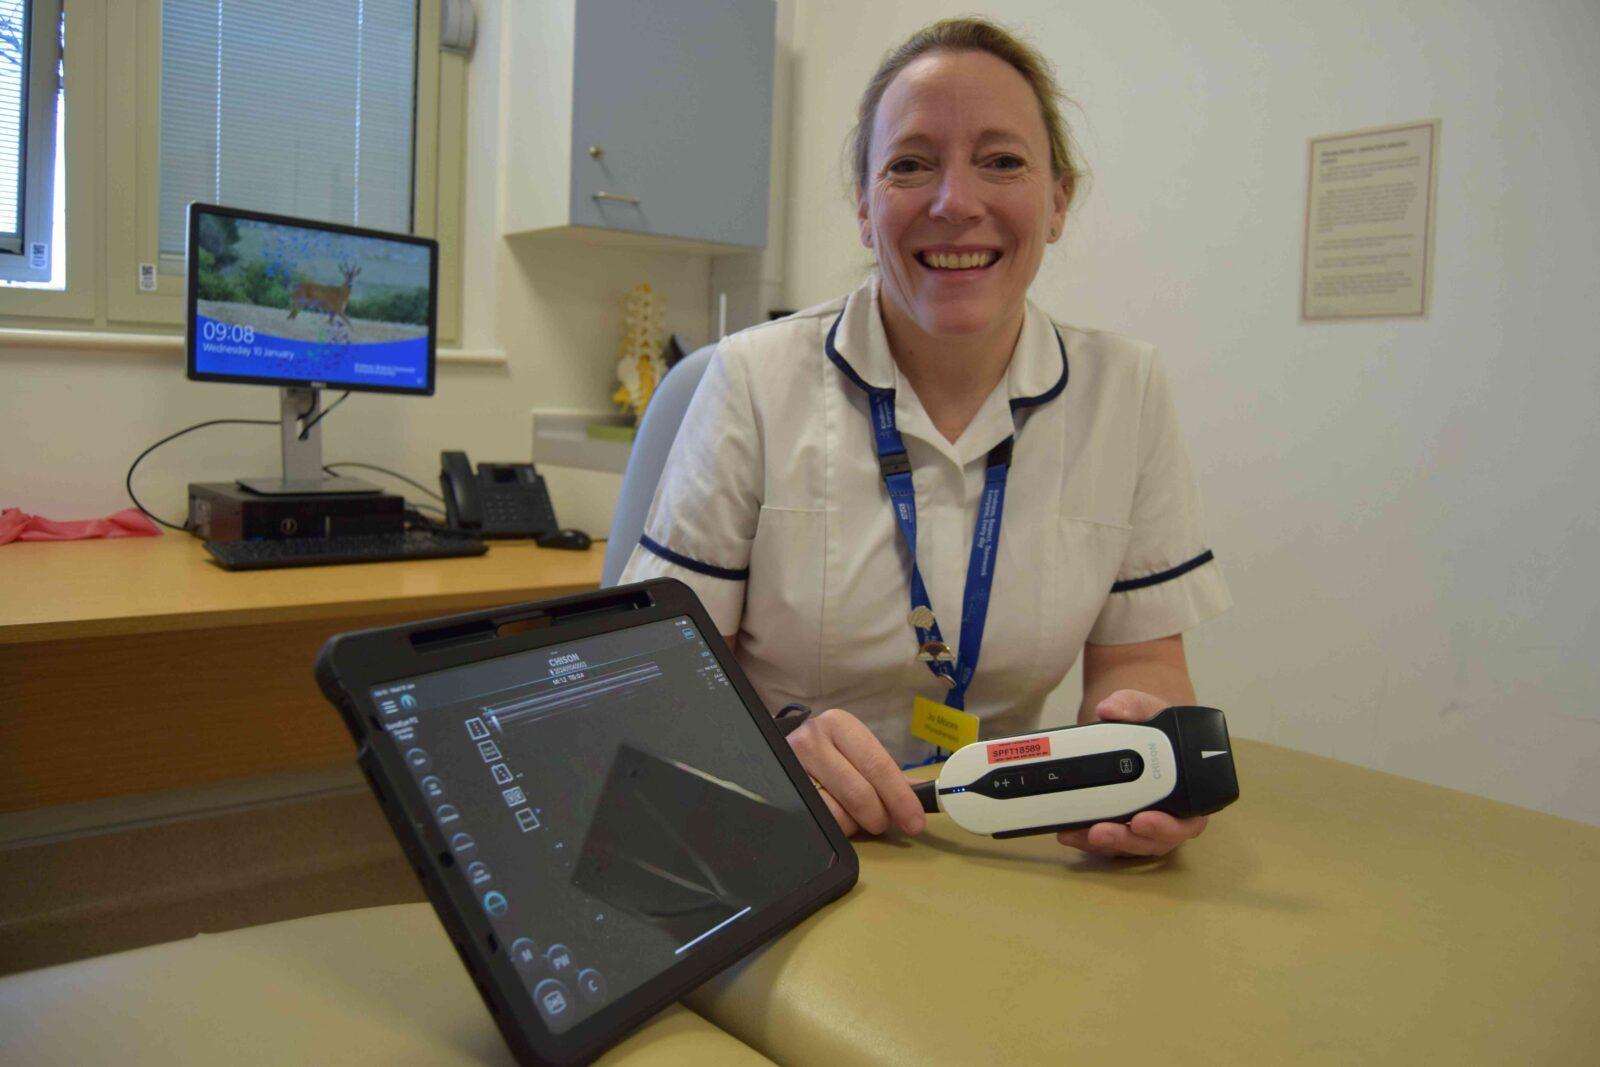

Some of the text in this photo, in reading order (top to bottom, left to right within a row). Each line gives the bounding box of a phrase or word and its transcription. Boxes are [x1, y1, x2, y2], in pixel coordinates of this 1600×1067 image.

[203, 320, 255, 344] 09:08
[202, 342, 251, 358] Wednesday
[263, 347, 295, 361] January
[549, 653, 580, 667] CHISON
[992, 744, 1041, 758] SPFT18589
[1148, 743, 1162, 780] CHISON
